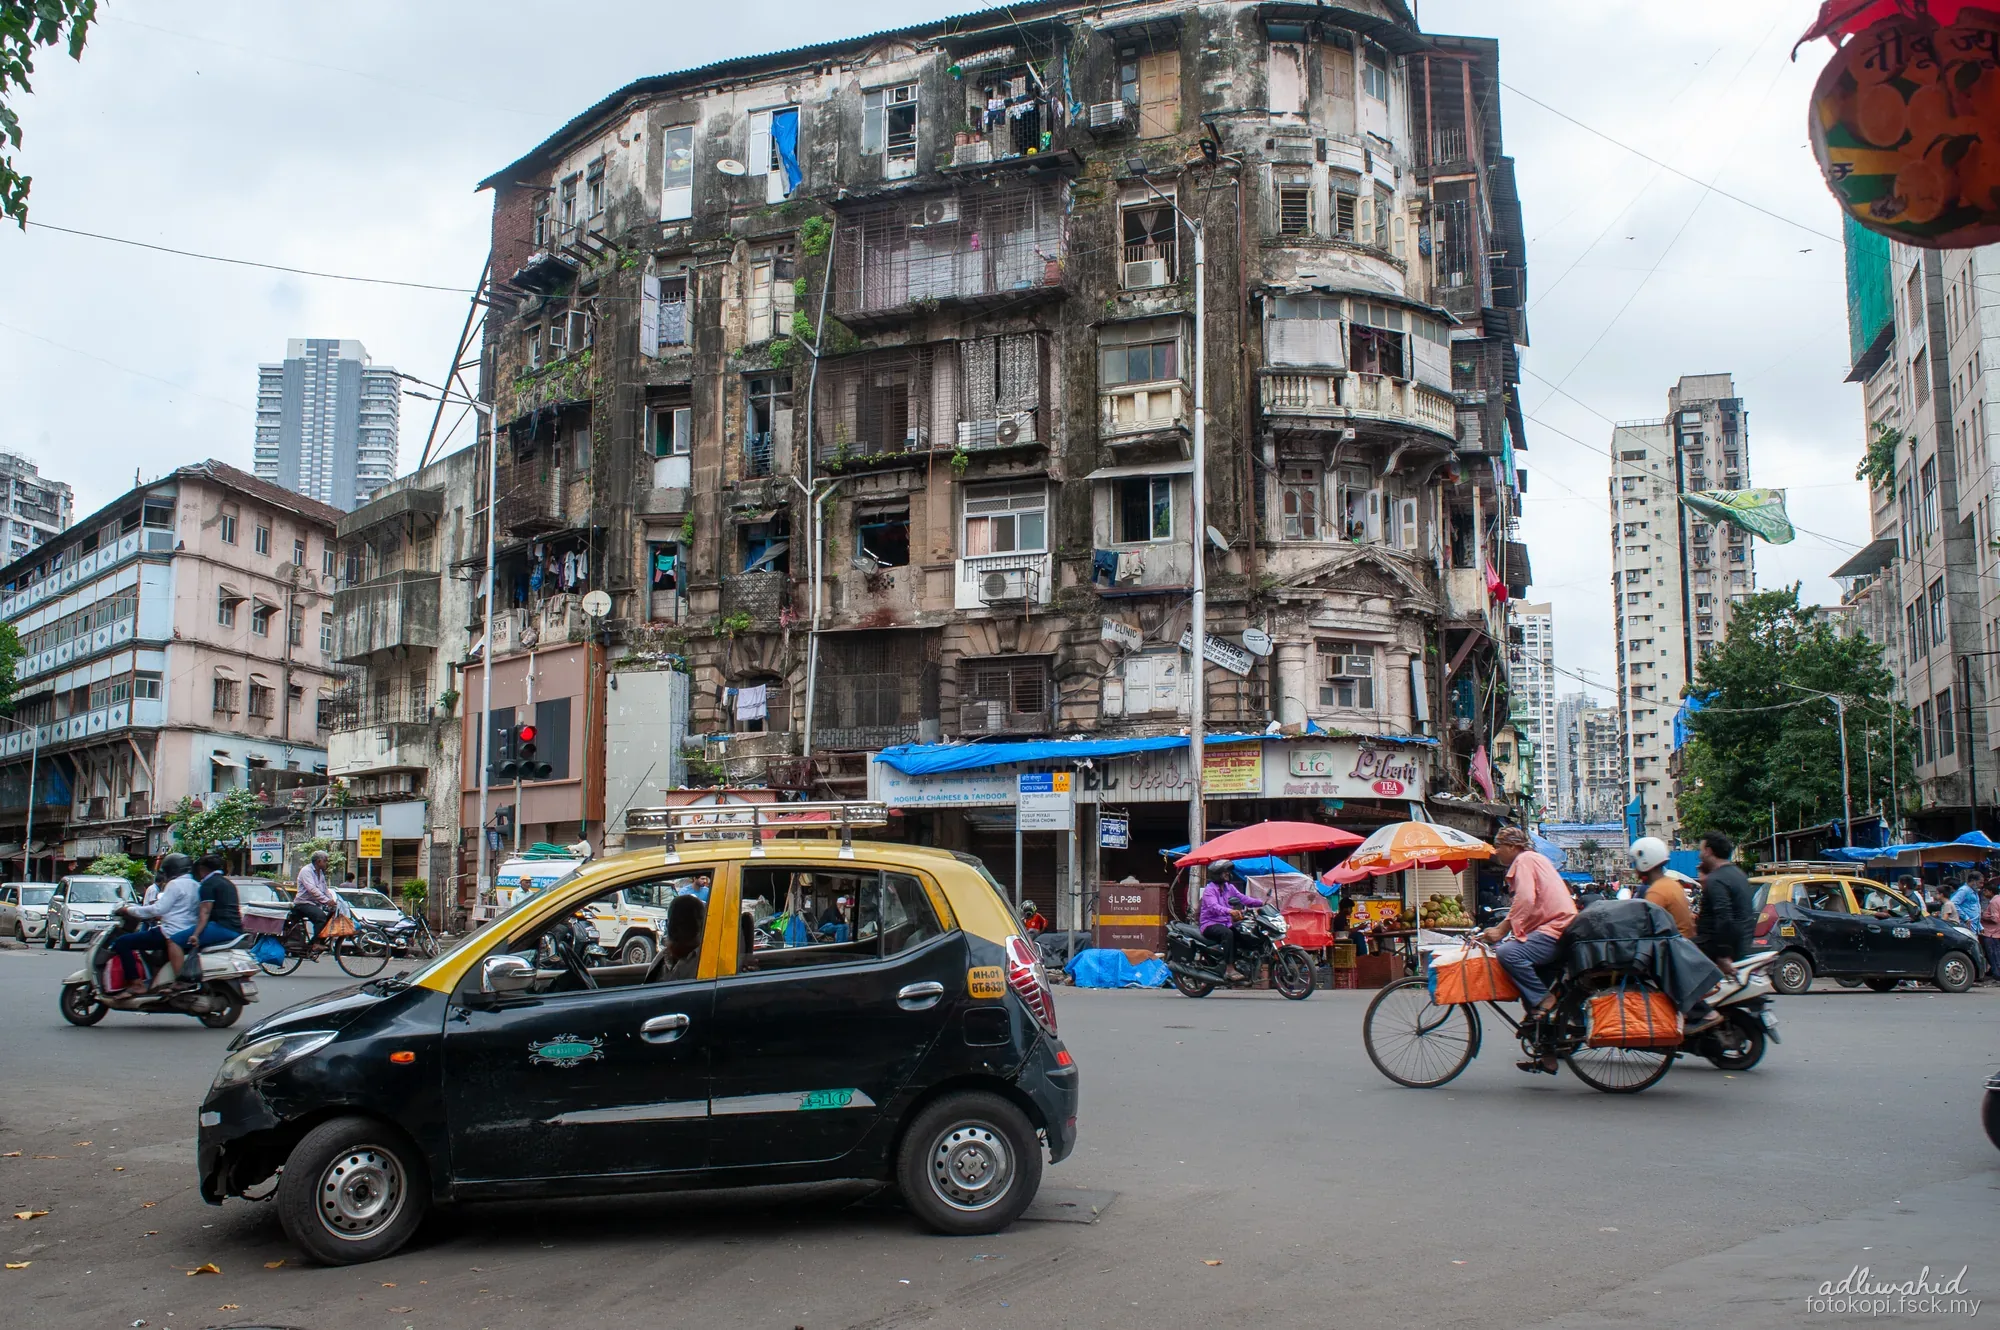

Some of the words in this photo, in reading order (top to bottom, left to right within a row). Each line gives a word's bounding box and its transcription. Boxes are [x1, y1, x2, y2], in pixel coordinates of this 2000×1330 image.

[1115, 624, 1138, 639] CLINIC
[1349, 751, 1418, 785] Liberty
[1381, 781, 1398, 791] TEA
[894, 794, 924, 803] MOGHLAI
[926, 793, 960, 801] CHAINESE
[971, 792, 1007, 800] TANDOOR
